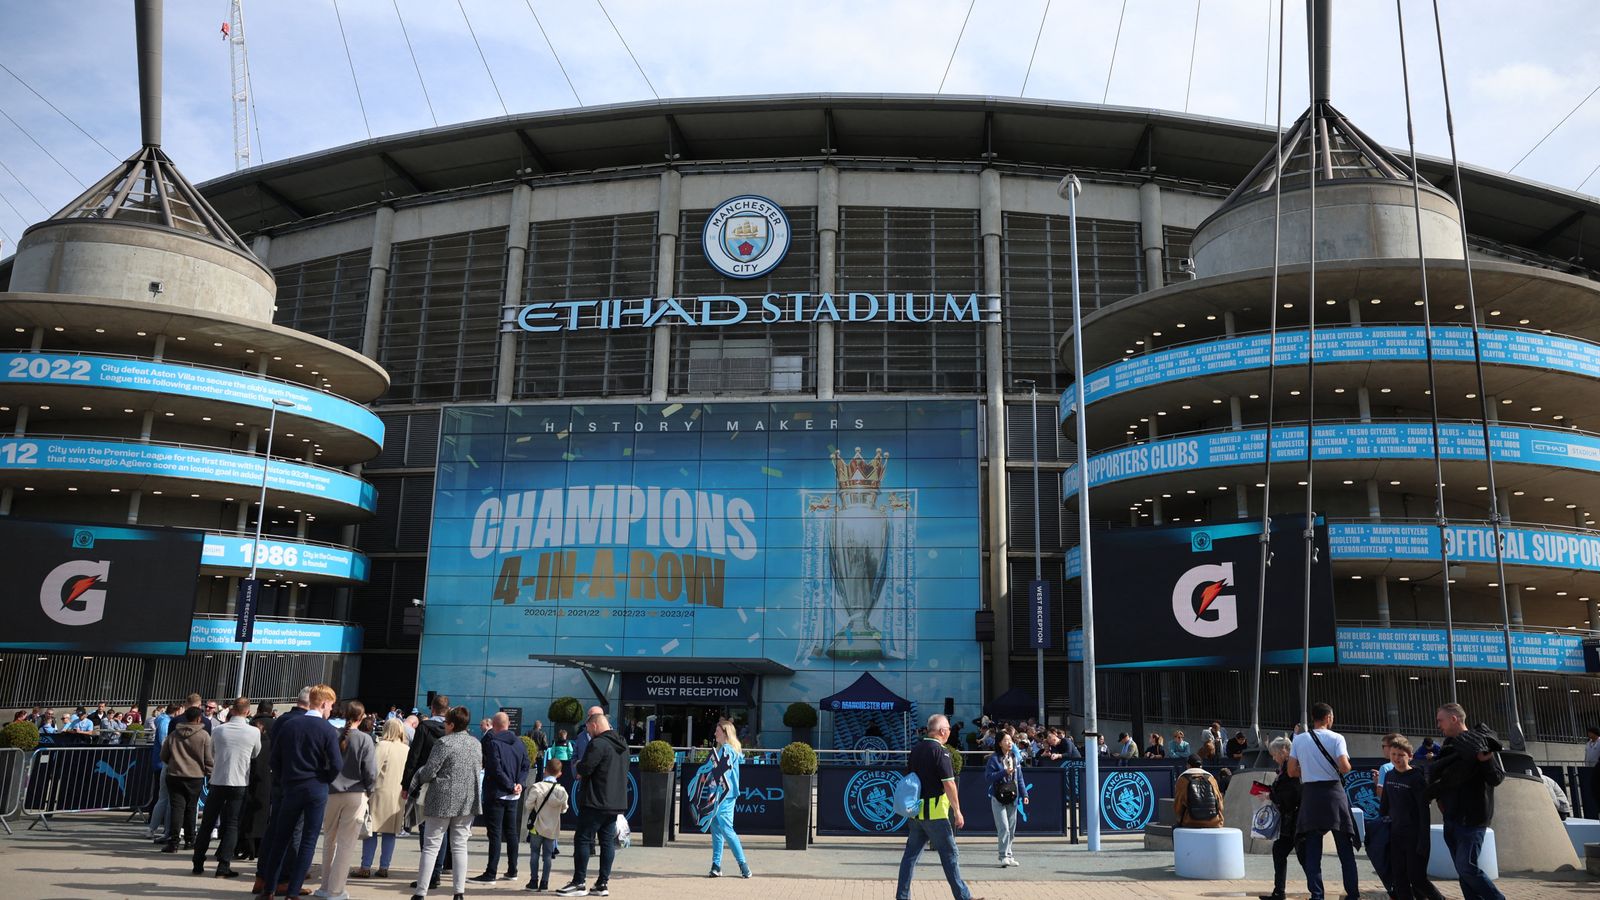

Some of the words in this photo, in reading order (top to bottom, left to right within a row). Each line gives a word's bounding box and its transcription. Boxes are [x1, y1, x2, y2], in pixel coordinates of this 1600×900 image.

[712, 201, 781, 228] MANCHESTER
[733, 264, 758, 273] CITY
[517, 296, 749, 332] ETIHAD
[761, 292, 982, 324] STADIUM
[8, 358, 92, 381] 2022
[101, 363, 119, 373] City
[121, 365, 149, 375] defeat
[150, 368, 176, 378] Aston
[177, 371, 196, 382] Villa
[197, 375, 205, 383] to
[206, 377, 232, 387] secure
[233, 380, 246, 389] the
[100, 372, 132, 384] League
[133, 376, 150, 385] title
[151, 377, 192, 390] following
[192, 384, 223, 395] another
[224, 388, 257, 399] dramatic
[545, 420, 694, 433] HISTORY
[727, 418, 864, 431] MAKERS
[1370, 427, 1396, 436] CITYZENS
[1535, 444, 1567, 453] ETIHAD
[48, 445, 67, 455] City
[68, 446, 86, 454] win
[87, 447, 102, 455] the
[103, 447, 140, 458] Premier
[141, 450, 172, 461] League
[173, 453, 186, 462] for
[187, 454, 201, 463] the
[202, 456, 219, 466] first
[220, 459, 237, 468] time
[237, 460, 254, 470] with
[1087, 447, 1149, 483] SUPPORTERS
[1151, 440, 1198, 469] CLUBS
[47, 454, 66, 463] that
[68, 456, 88, 464] saw
[89, 456, 118, 467] Sergio
[119, 458, 151, 469] Agüero
[152, 461, 177, 470] score
[178, 464, 189, 472] an
[190, 465, 214, 475] iconic
[215, 467, 231, 477] goal
[240, 469, 263, 480] added
[469, 485, 758, 561] CHAMPIONS
[1344, 527, 1364, 535] MALTA
[1401, 527, 1428, 536] CITYZENS
[1394, 537, 1409, 545] BLUE
[1411, 537, 1428, 545] MOON
[240, 543, 298, 567] 1986
[493, 549, 726, 608] 4-IN-A-ROW
[40, 559, 111, 626] G
[1172, 562, 1238, 638] G
[524, 608, 558, 618] 2020/21
[567, 608, 599, 618] 2021/22
[612, 609, 646, 618] 2022/23
[660, 609, 695, 619] 2023/24
[241, 603, 250, 637] RECEPTION
[193, 626, 210, 636] City
[211, 626, 232, 635] move
[264, 628, 281, 636] Road
[192, 635, 205, 644] the
[207, 635, 230, 644] Club's
[273, 638, 288, 646] next
[1378, 632, 1393, 641] ROSE
[1394, 632, 1407, 641] CITY
[1408, 633, 1420, 642] SKY
[1421, 633, 1440, 643] BLUES
[1361, 641, 1381, 650] SOUTH
[1382, 642, 1414, 652] YORKSHIRE
[1393, 652, 1429, 662] VANCOUVER
[646, 675, 676, 684] COLIN
[679, 675, 704, 684] BELL
[707, 676, 740, 686] STAND
[647, 687, 676, 696] WEST
[679, 688, 738, 697] RECEPTION
[841, 701, 881, 710] MANCHESTER
[881, 702, 894, 710] CITY
[849, 771, 900, 799] MANCHESTE
[1105, 772, 1145, 799] MANCHESTER
[735, 804, 766, 814] WAYS
[876, 820, 894, 831] CITY
[1126, 819, 1141, 829] CITY
